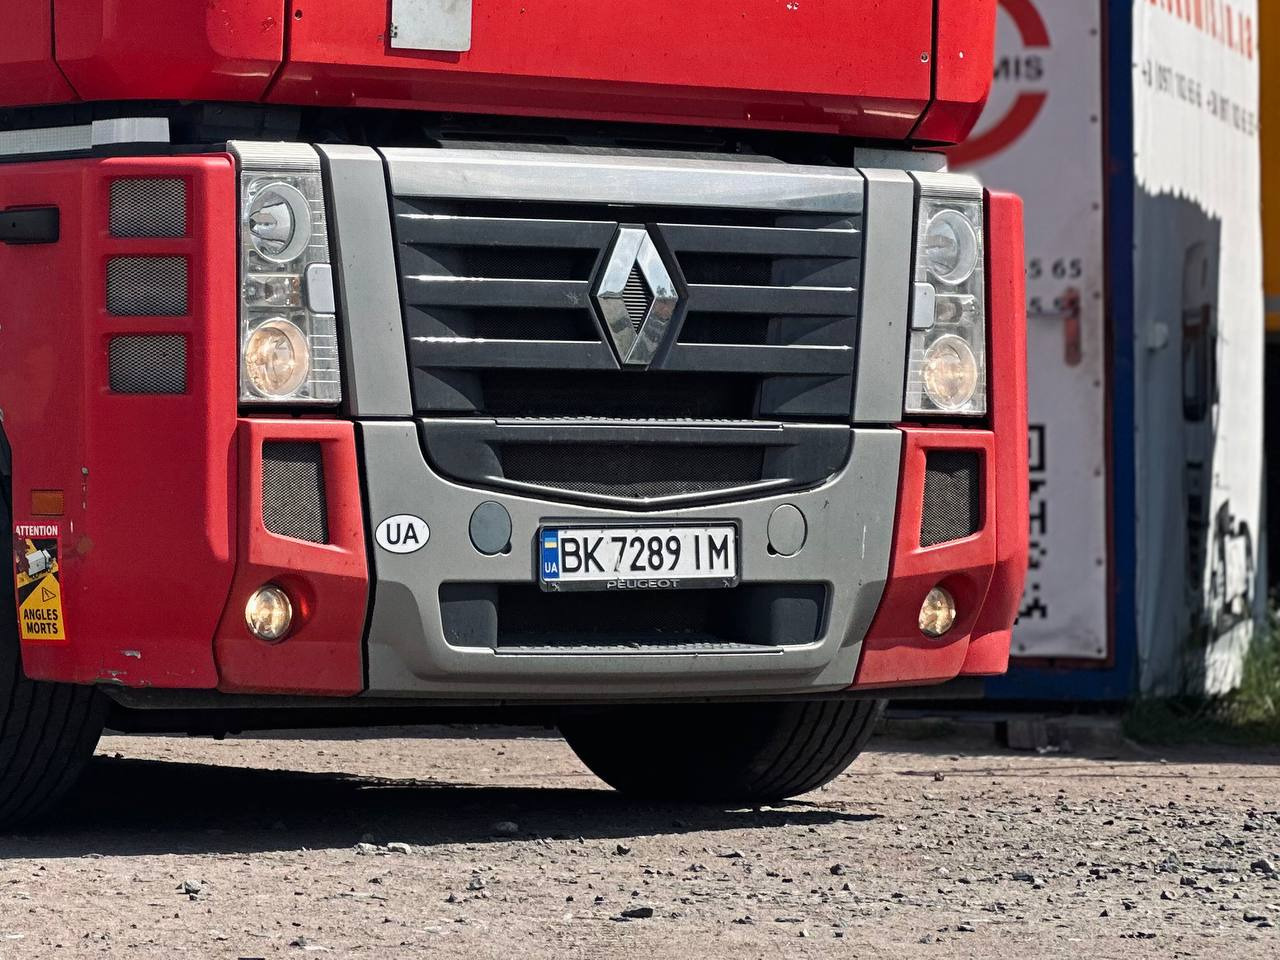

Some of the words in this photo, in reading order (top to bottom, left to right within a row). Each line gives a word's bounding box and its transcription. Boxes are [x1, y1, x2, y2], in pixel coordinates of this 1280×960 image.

[16, 524, 58, 537] ATTENTION
[385, 523, 419, 546] UA
[561, 536, 605, 573] BK
[611, 534, 681, 572] 7289
[695, 533, 729, 571] IM
[544, 561, 558, 573] UA
[606, 578, 681, 590] PEUGEOT
[23, 608, 58, 621] ANGLES
[26, 621, 58, 635] MORTS
